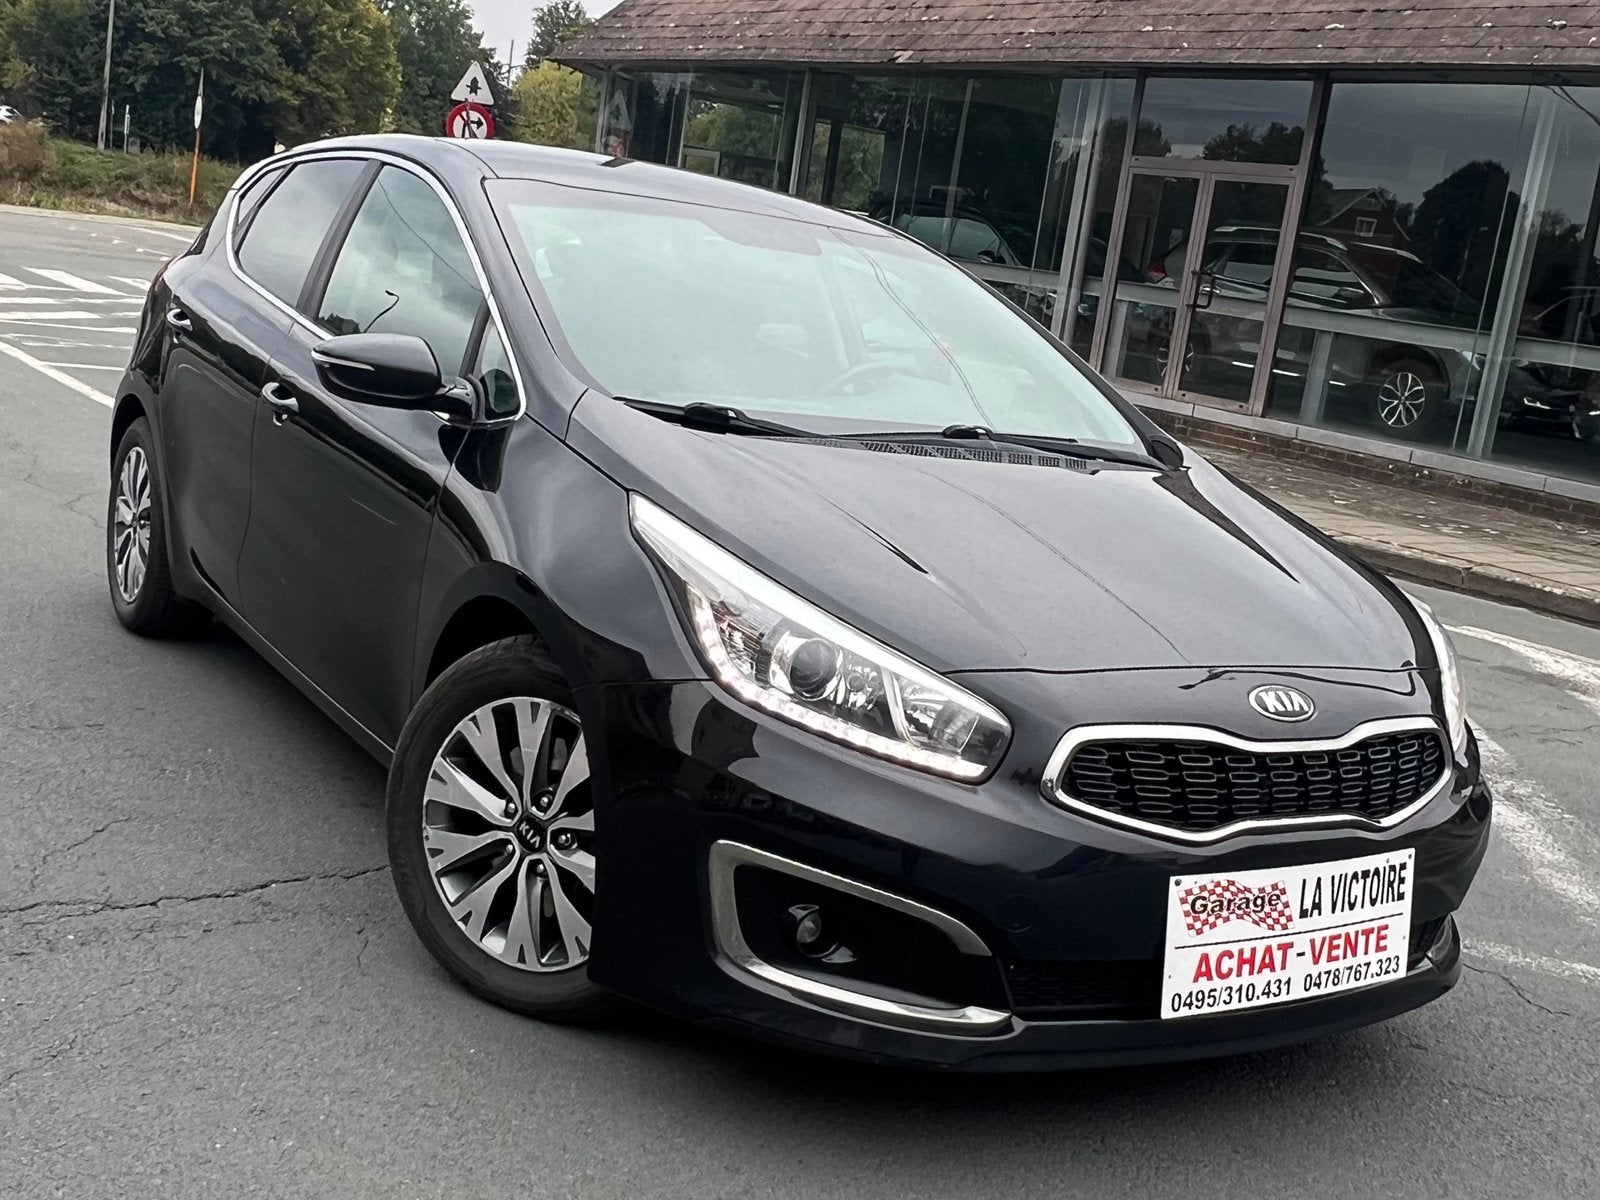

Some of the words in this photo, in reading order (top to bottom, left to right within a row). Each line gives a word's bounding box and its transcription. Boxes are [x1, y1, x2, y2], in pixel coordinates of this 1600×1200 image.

[1258, 690, 1310, 713] KIA
[519, 821, 541, 849] KIA
[1190, 893, 1282, 917] Garage
[1299, 877, 1323, 920] LA
[1330, 861, 1407, 915] VICTOIRE
[1171, 976, 1292, 1013] 0495/310.431
[1303, 955, 1401, 992] 0478/767.323
